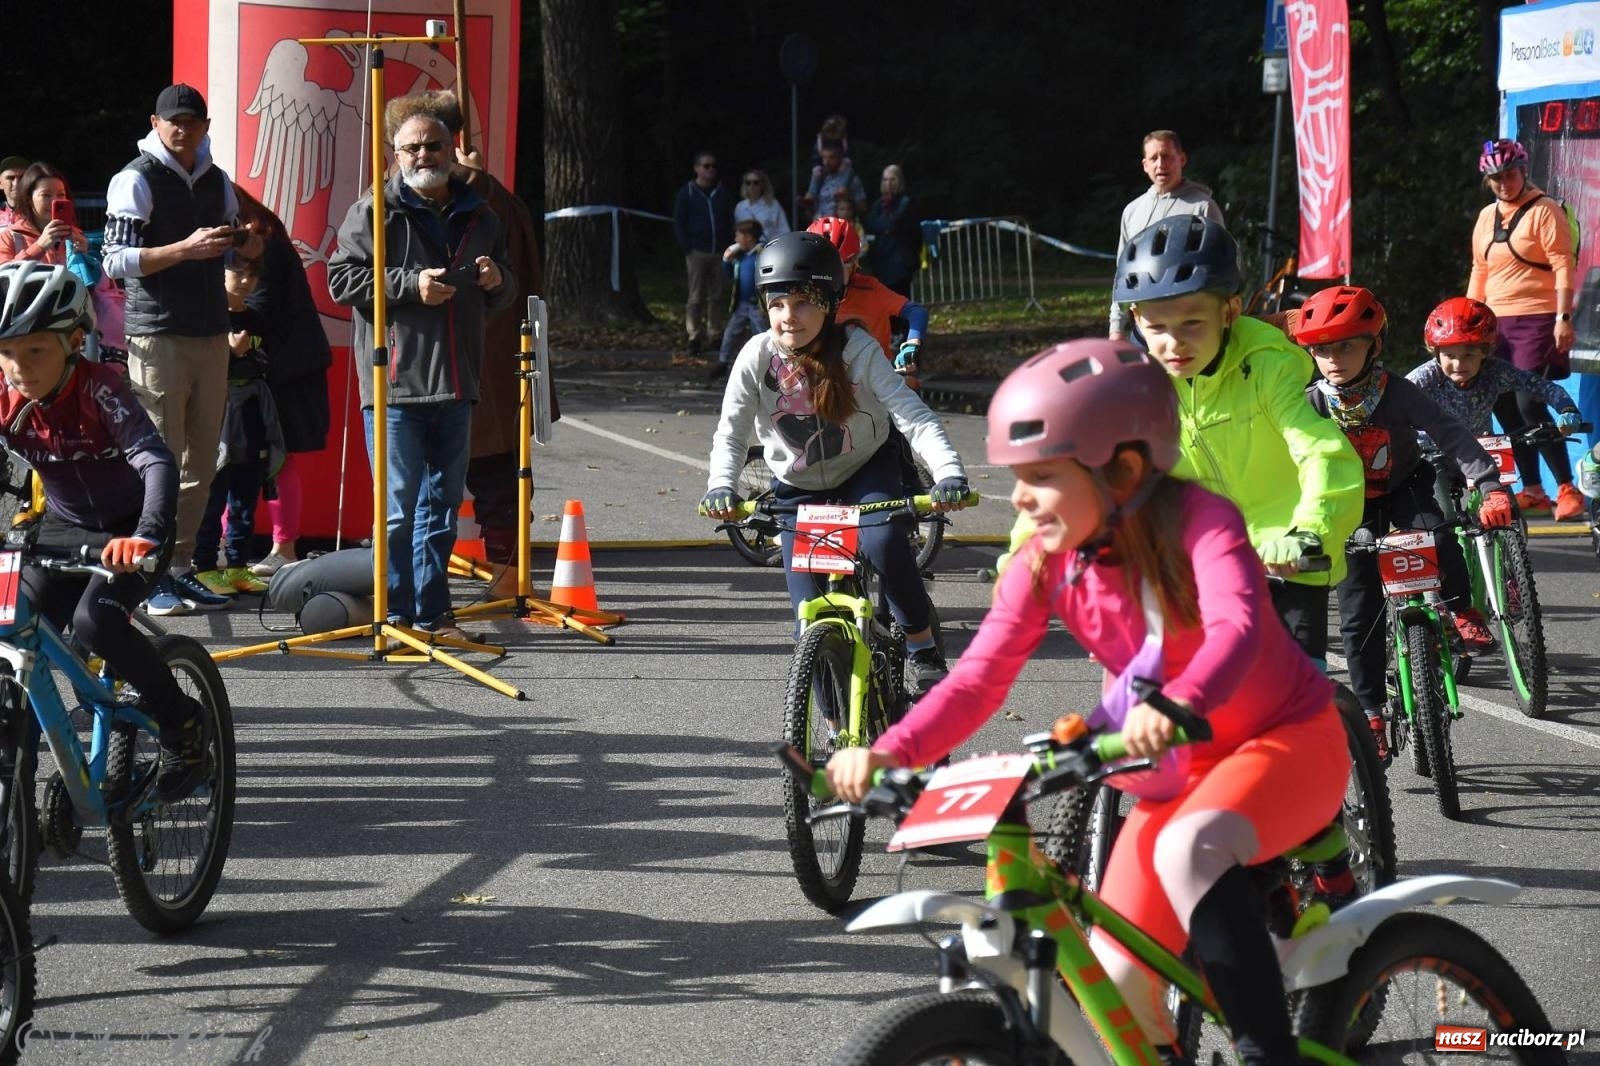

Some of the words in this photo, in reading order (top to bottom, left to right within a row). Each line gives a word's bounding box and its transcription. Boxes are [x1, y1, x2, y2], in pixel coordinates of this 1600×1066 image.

[1510, 37, 1561, 61] PersonalBest
[1392, 555, 1425, 574] 93
[936, 784, 992, 815] 77
